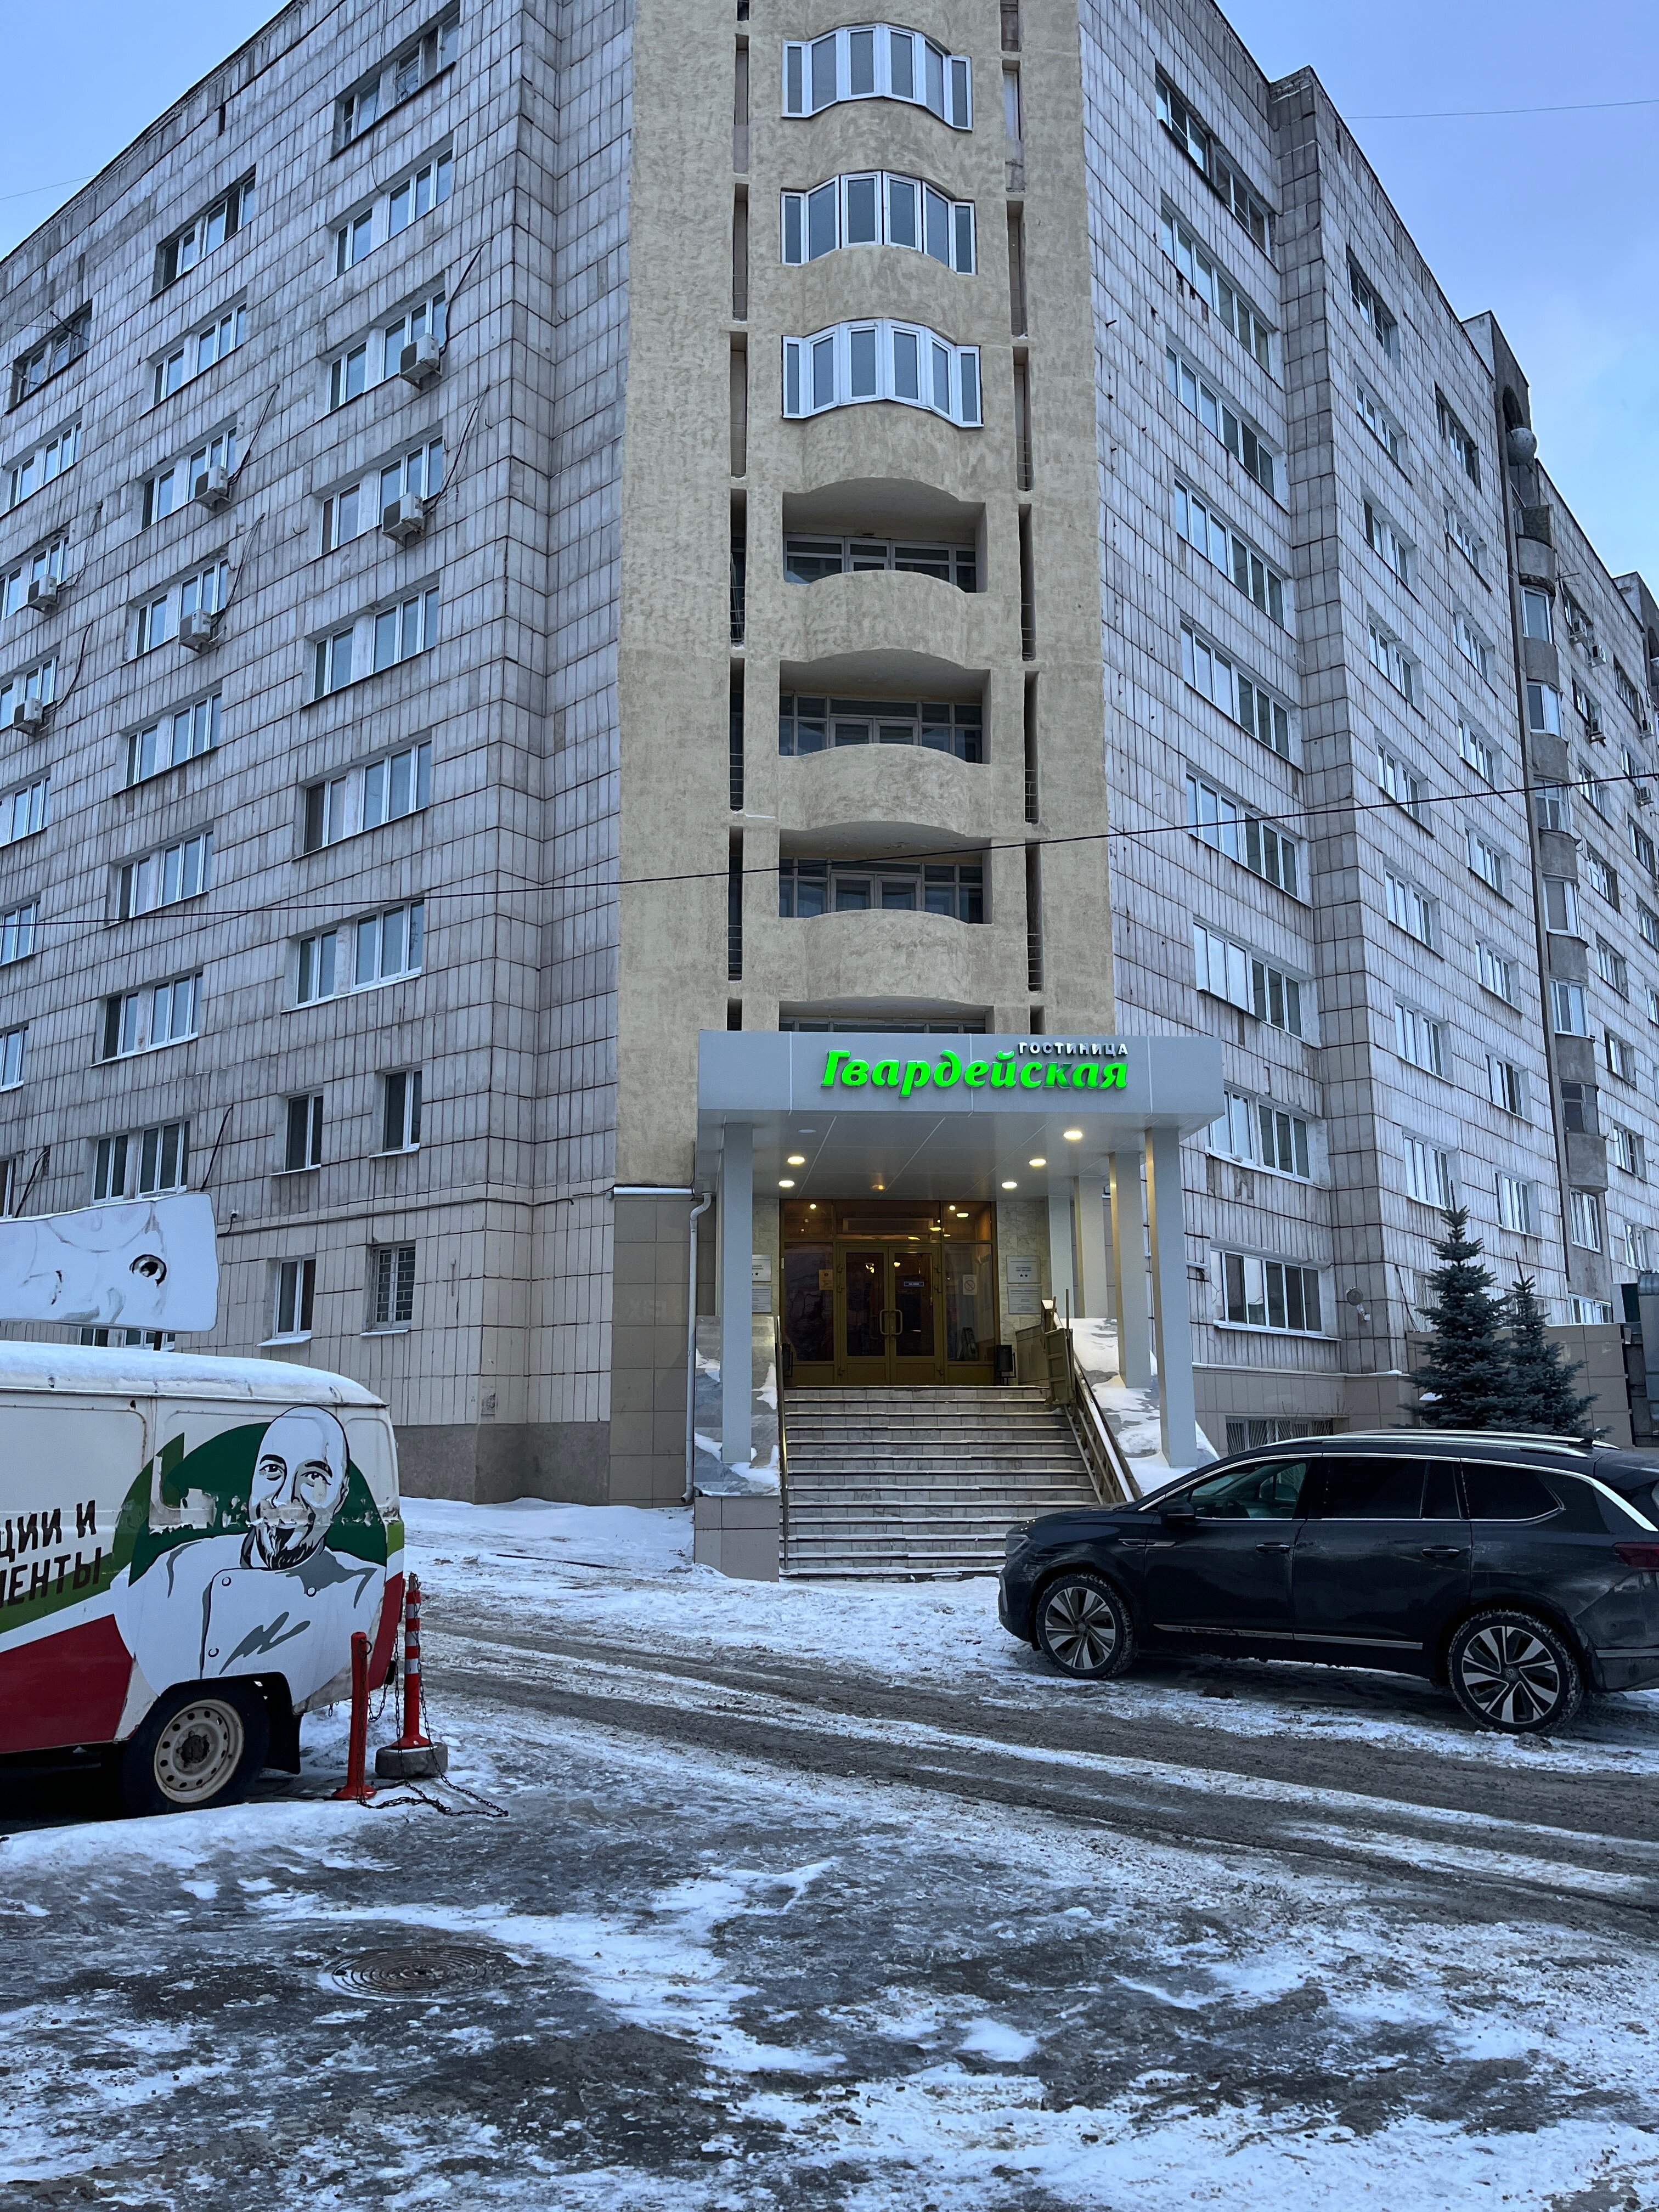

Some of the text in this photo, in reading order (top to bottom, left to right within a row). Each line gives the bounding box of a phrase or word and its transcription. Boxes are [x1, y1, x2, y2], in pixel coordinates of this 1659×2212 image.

[1018, 1042, 1128, 1057] ГОСТИНИЦА
[821, 1049, 1128, 1097] Гвардейская
[76, 1500, 97, 1538] И
